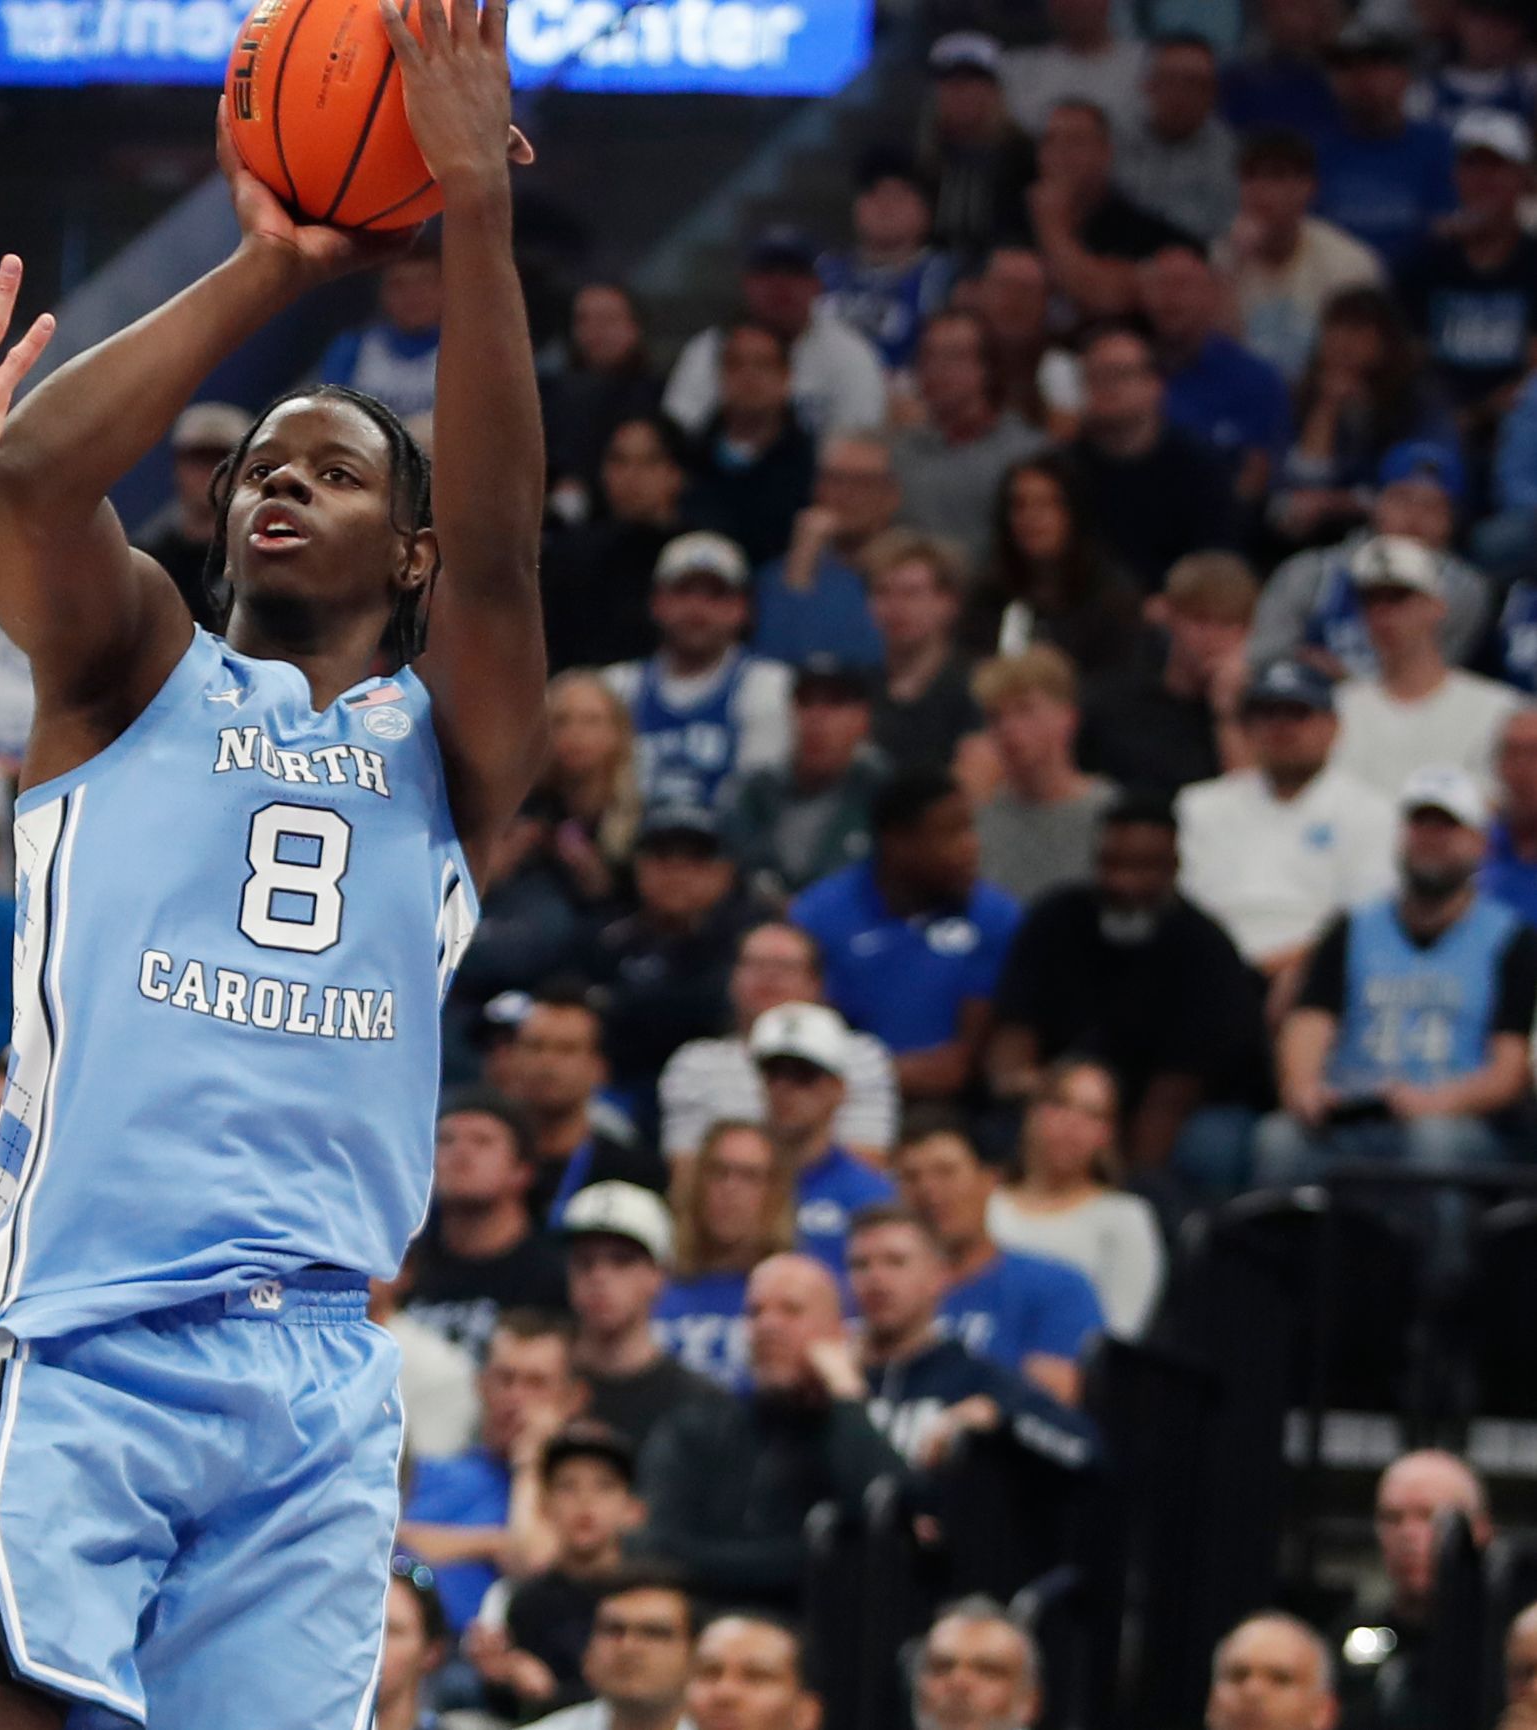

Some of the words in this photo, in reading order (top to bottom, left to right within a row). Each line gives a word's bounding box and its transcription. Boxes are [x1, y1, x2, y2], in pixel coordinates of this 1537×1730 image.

[213, 726, 390, 799] NORTH
[237, 800, 352, 954] 8
[138, 948, 395, 1041] CAROLINA
